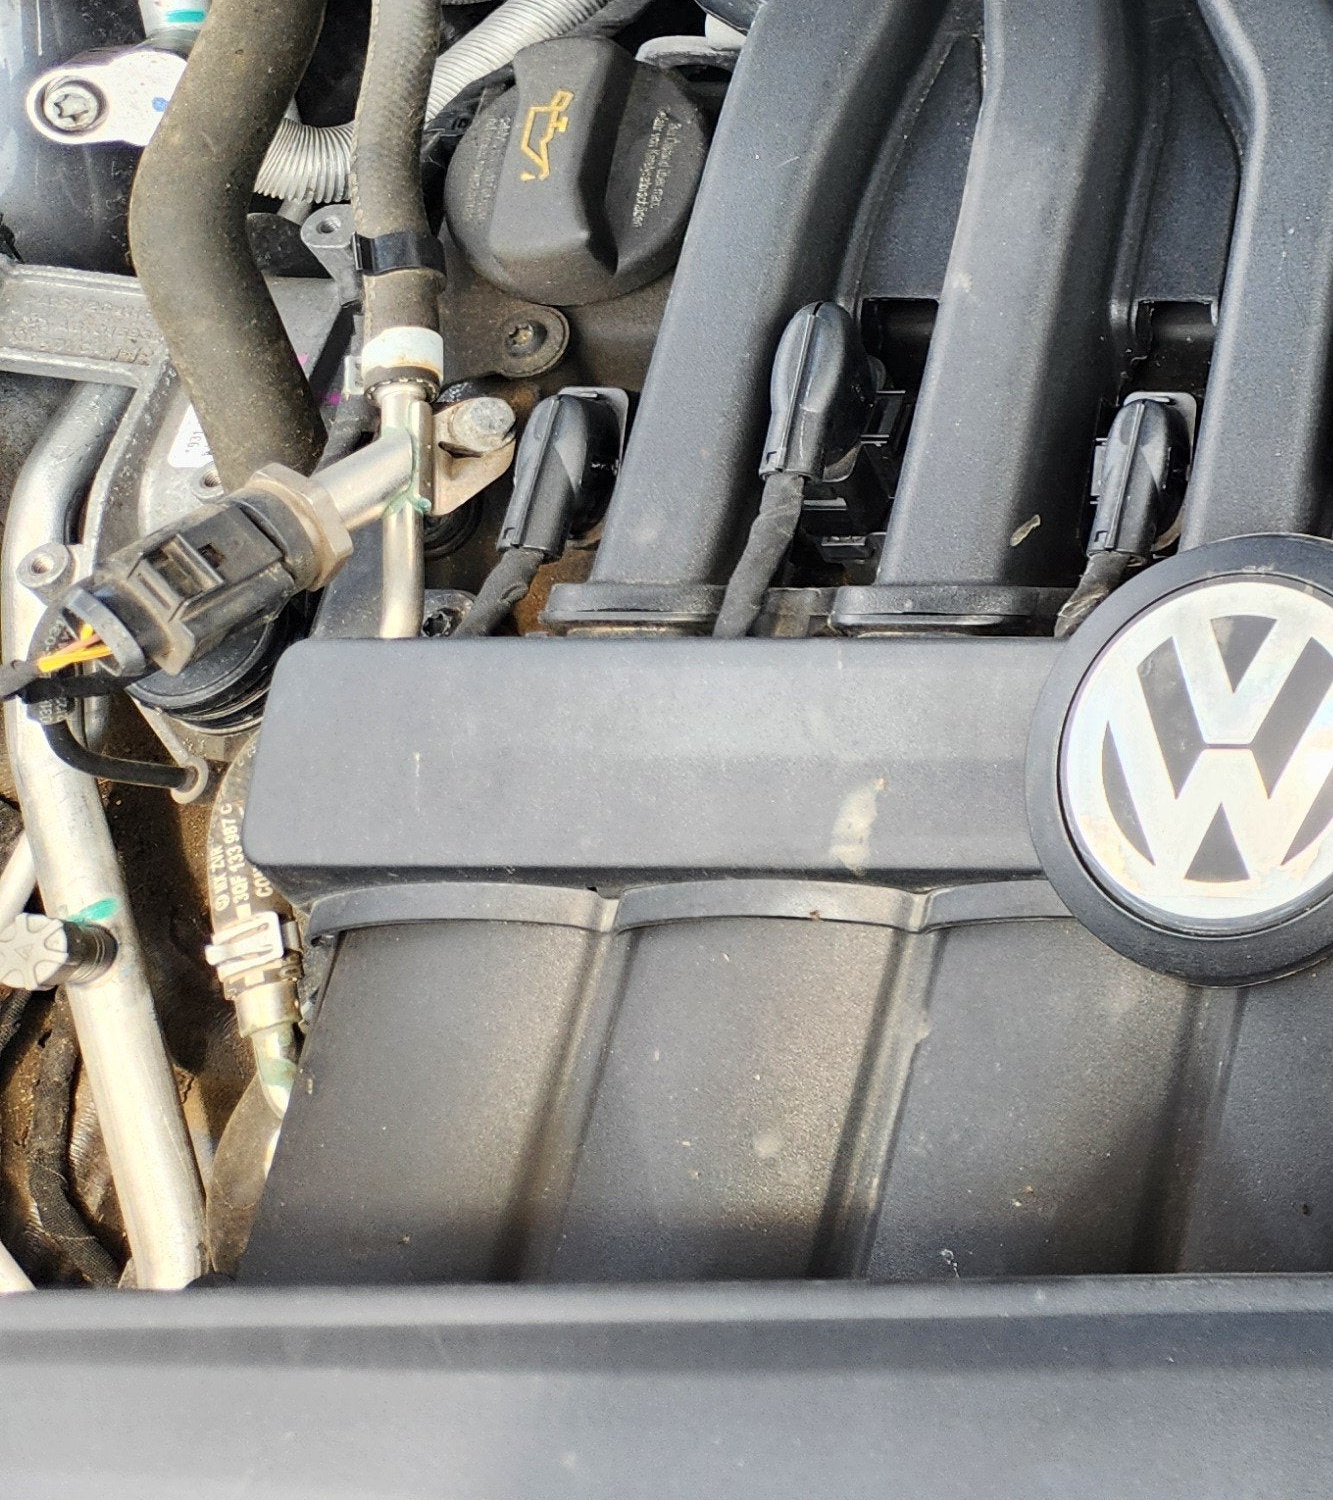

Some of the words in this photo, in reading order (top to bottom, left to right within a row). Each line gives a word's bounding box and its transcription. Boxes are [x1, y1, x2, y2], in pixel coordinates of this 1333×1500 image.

[221, 803, 233, 815] C
[222, 819, 240, 844] 987
[226, 845, 246, 873] 133
